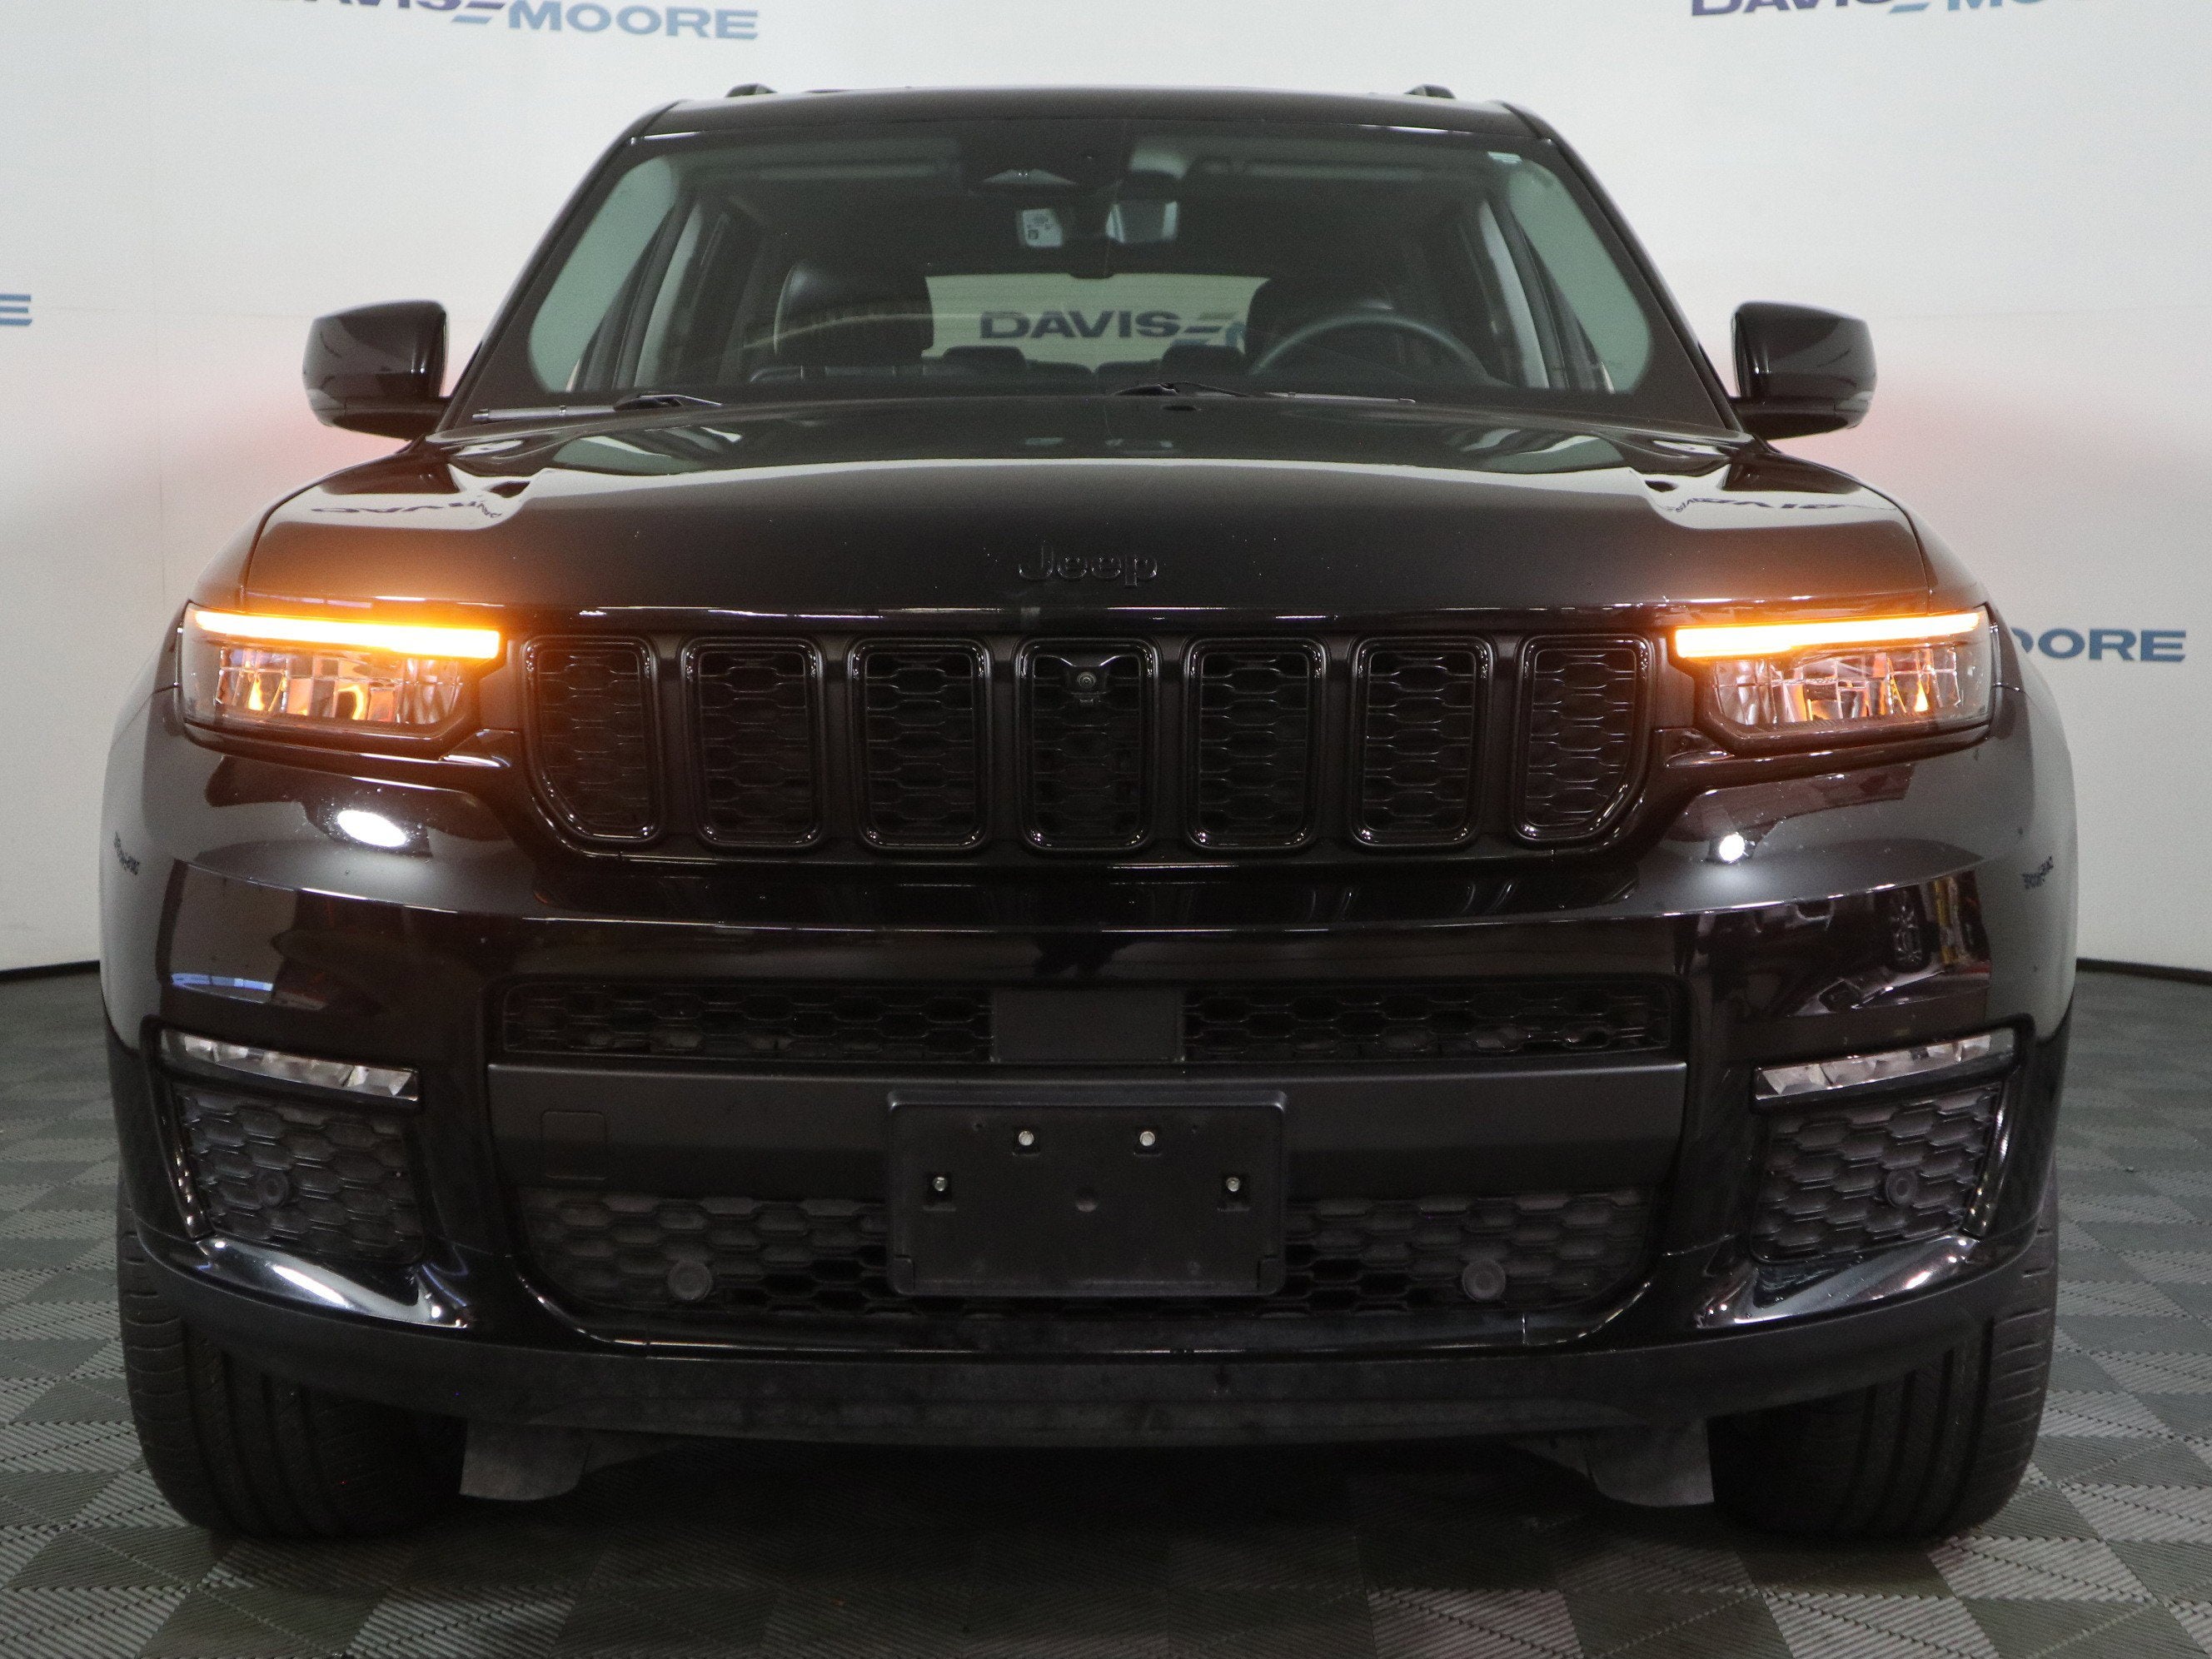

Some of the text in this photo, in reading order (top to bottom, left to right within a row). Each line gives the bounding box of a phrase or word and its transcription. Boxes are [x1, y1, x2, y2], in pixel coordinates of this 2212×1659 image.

[508, 0, 758, 39] MOORE
[980, 311, 1181, 339] DAVIS
[1018, 541, 1158, 587] Jeep
[2010, 627, 2186, 662] ORE
